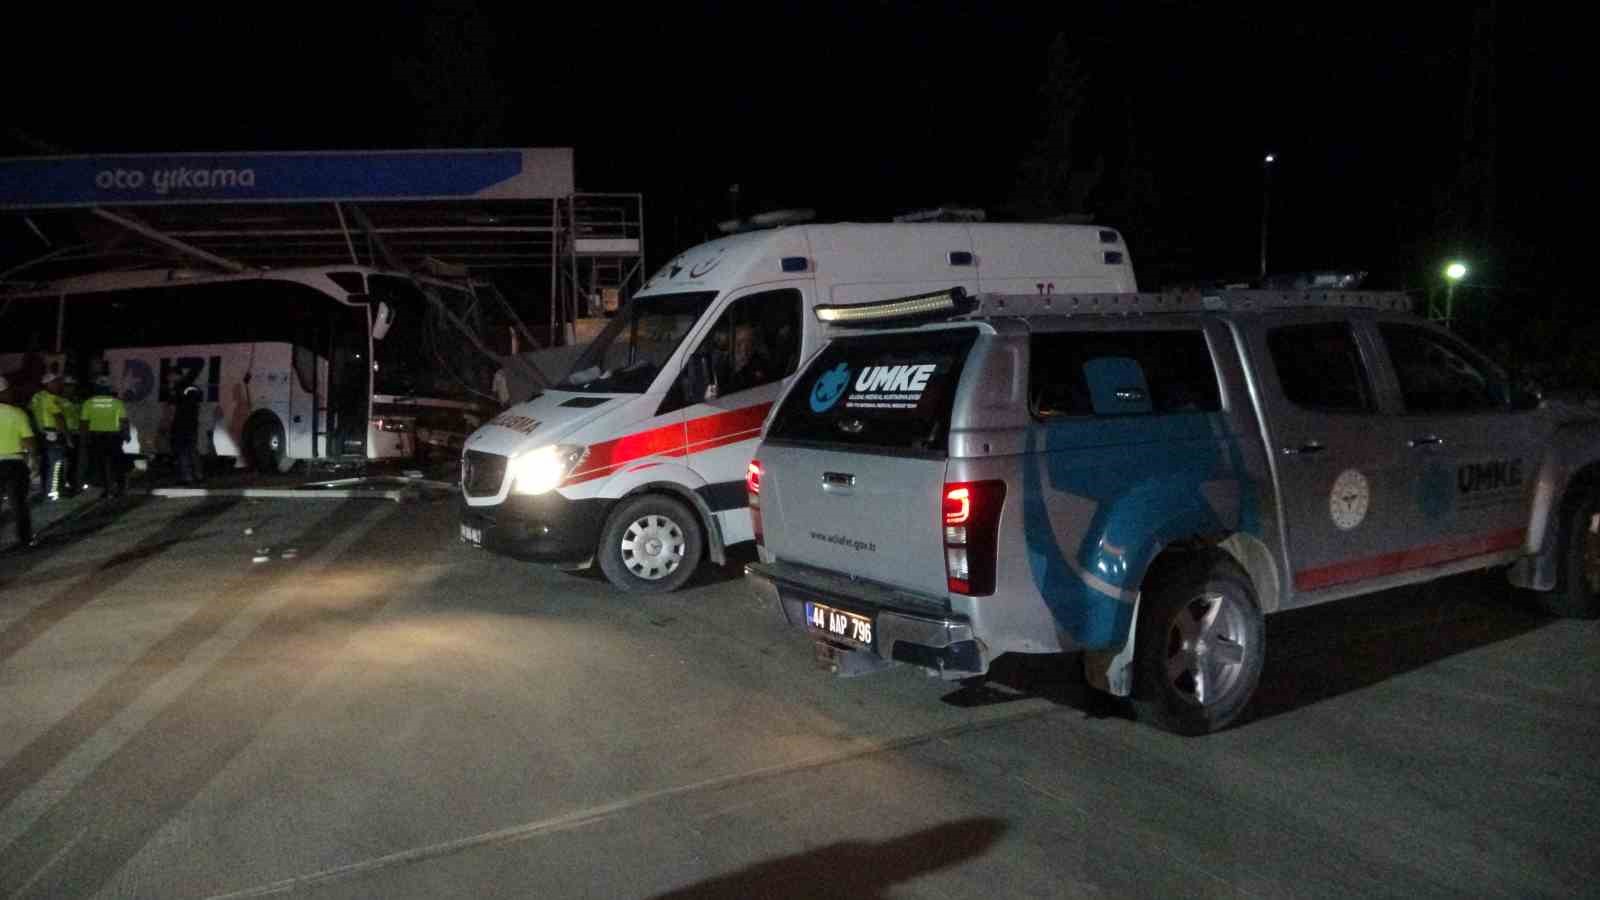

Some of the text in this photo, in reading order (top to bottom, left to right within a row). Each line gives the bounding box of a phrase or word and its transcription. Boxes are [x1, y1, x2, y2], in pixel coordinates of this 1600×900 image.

[96, 168, 145, 189] oto
[855, 364, 937, 392] UMKE
[812, 607, 872, 644] 44 AAP 796
